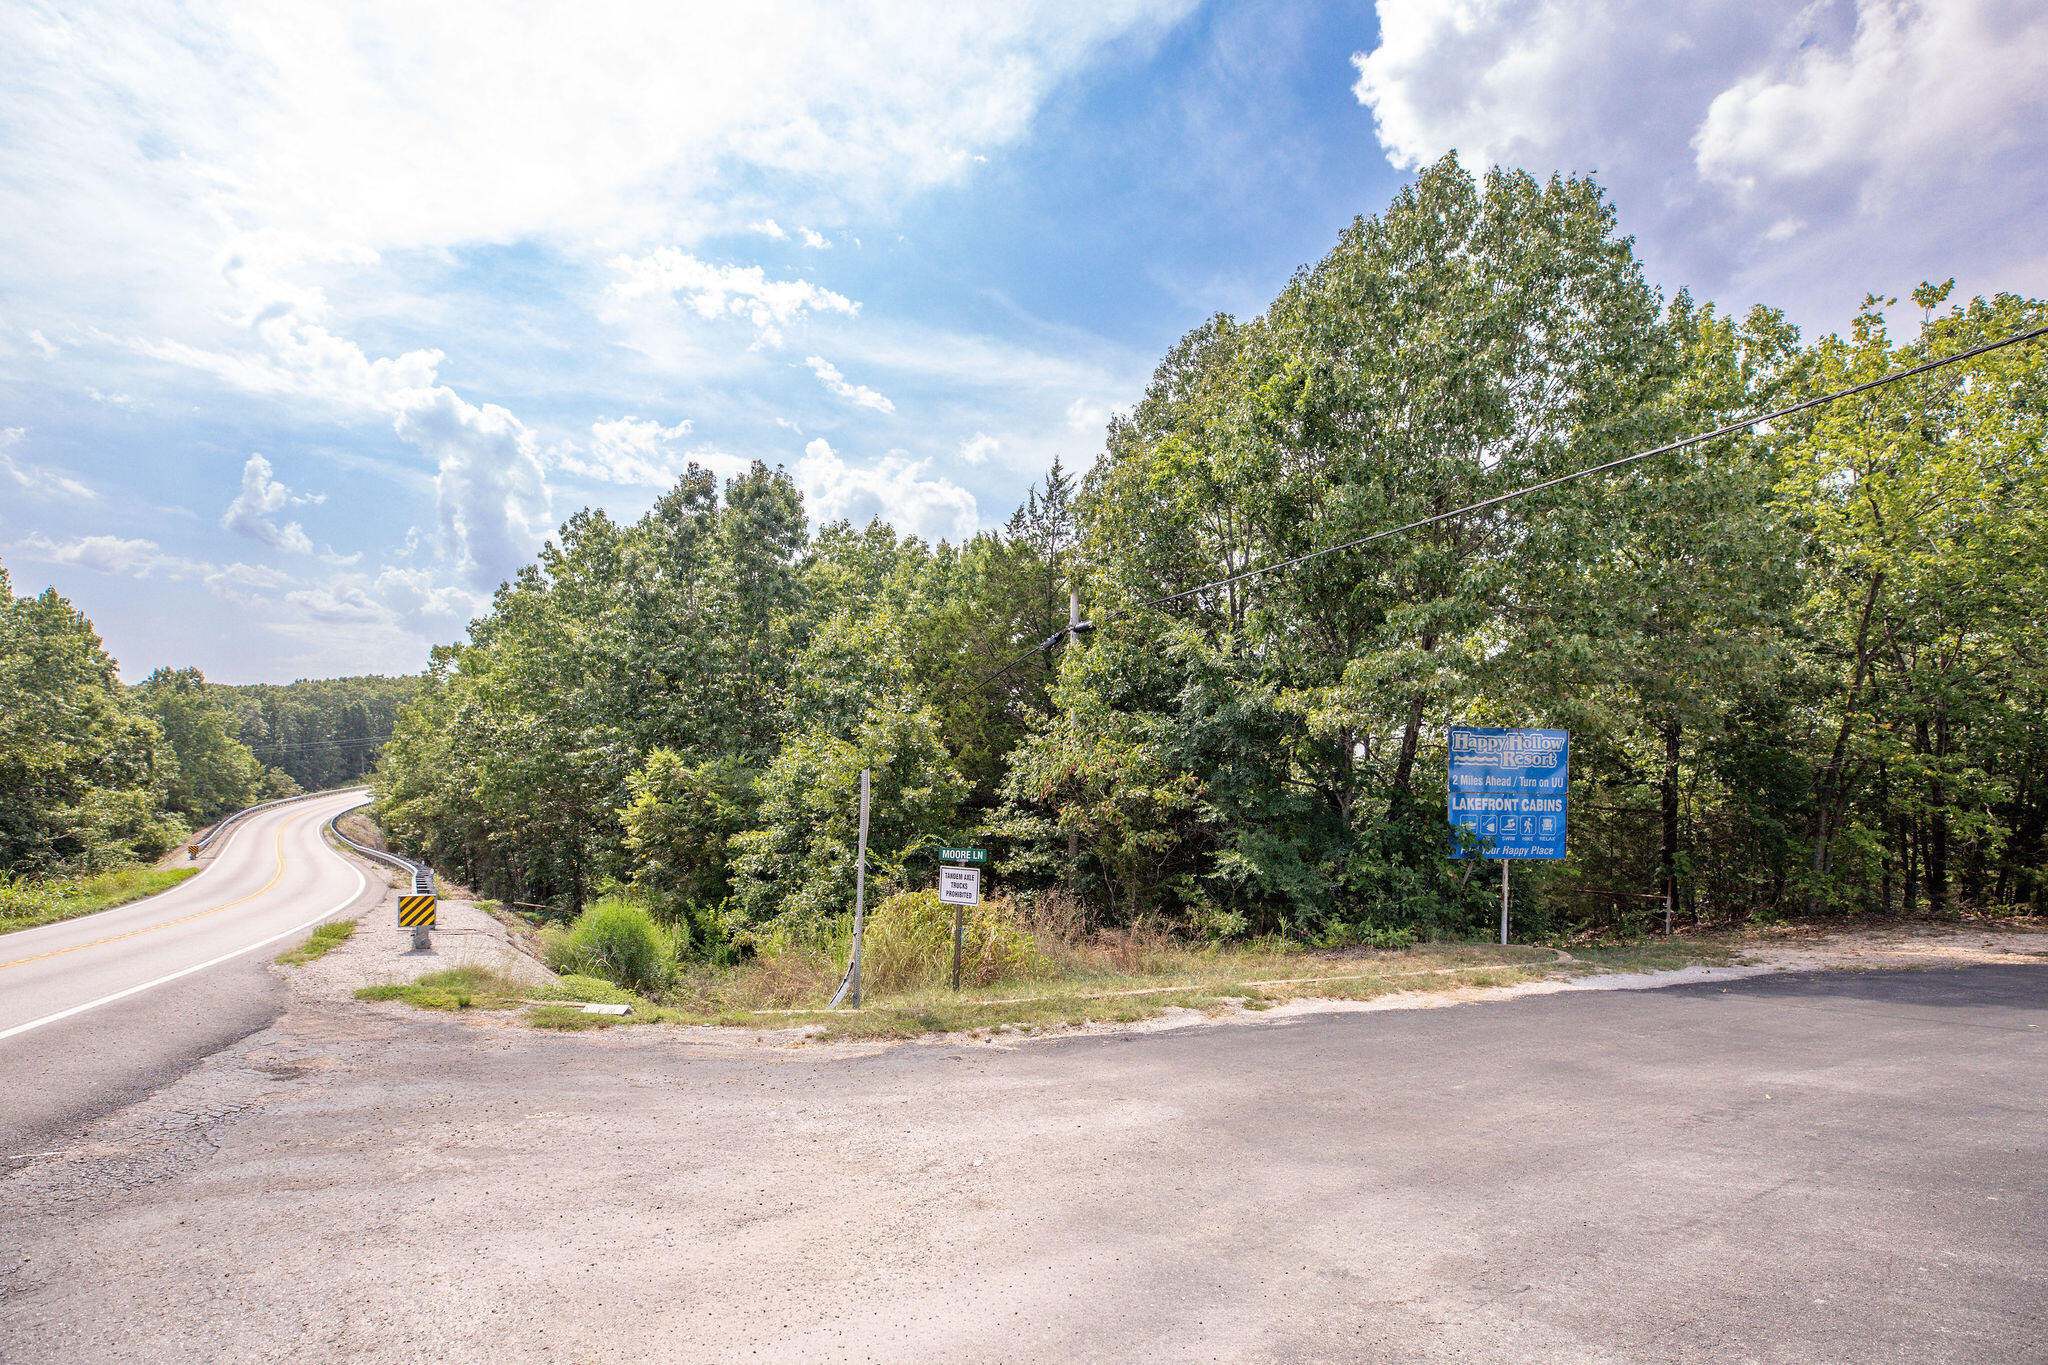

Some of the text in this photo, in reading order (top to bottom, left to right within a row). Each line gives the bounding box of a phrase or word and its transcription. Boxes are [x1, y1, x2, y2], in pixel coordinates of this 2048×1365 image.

[1453, 732, 1563, 752] Happy Hollow
[1502, 751, 1556, 767] Resort
[1452, 774, 1458, 785] 2
[1460, 775, 1483, 786] Miles
[1485, 775, 1511, 787] Ahead
[1519, 776, 1537, 787] Turn
[1539, 779, 1549, 787] on
[1551, 777, 1564, 788] UU
[1452, 797, 1563, 812] LAKEFRONT CABINS
[942, 850, 983, 860] MOORE LN
[1502, 845, 1529, 857] Happy
[1530, 846, 1554, 855] Place
[945, 872, 963, 880] TANDEM
[946, 890, 972, 899] PROHIBITED
